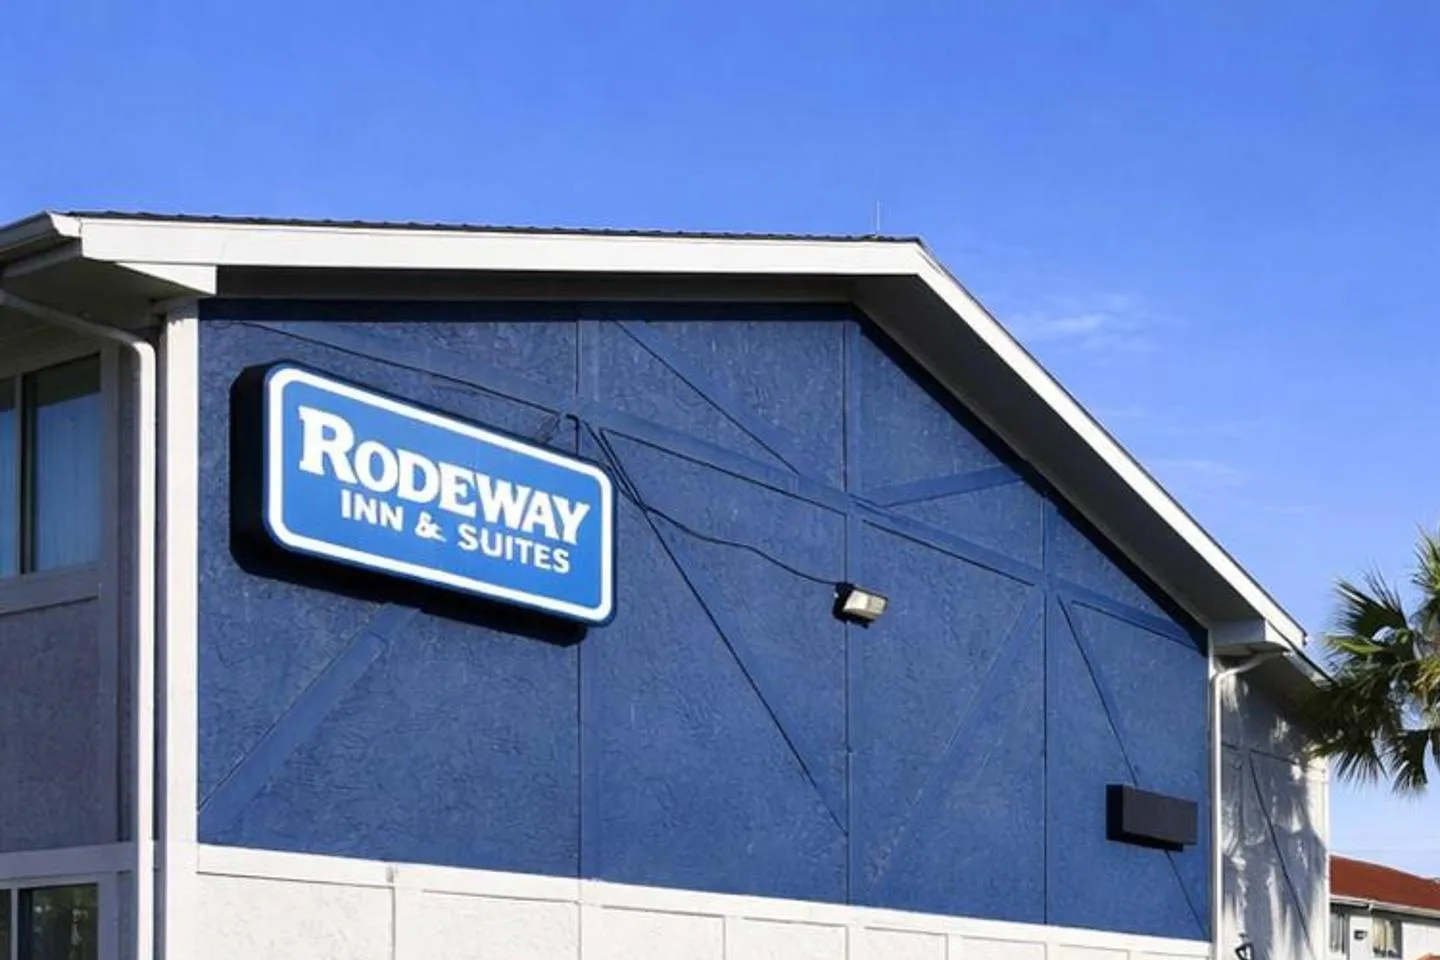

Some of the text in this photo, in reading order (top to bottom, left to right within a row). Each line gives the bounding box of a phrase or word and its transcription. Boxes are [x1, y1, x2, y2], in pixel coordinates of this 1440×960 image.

[298, 406, 590, 545] RODEWAY
[341, 489, 571, 575] INN & SUITES
